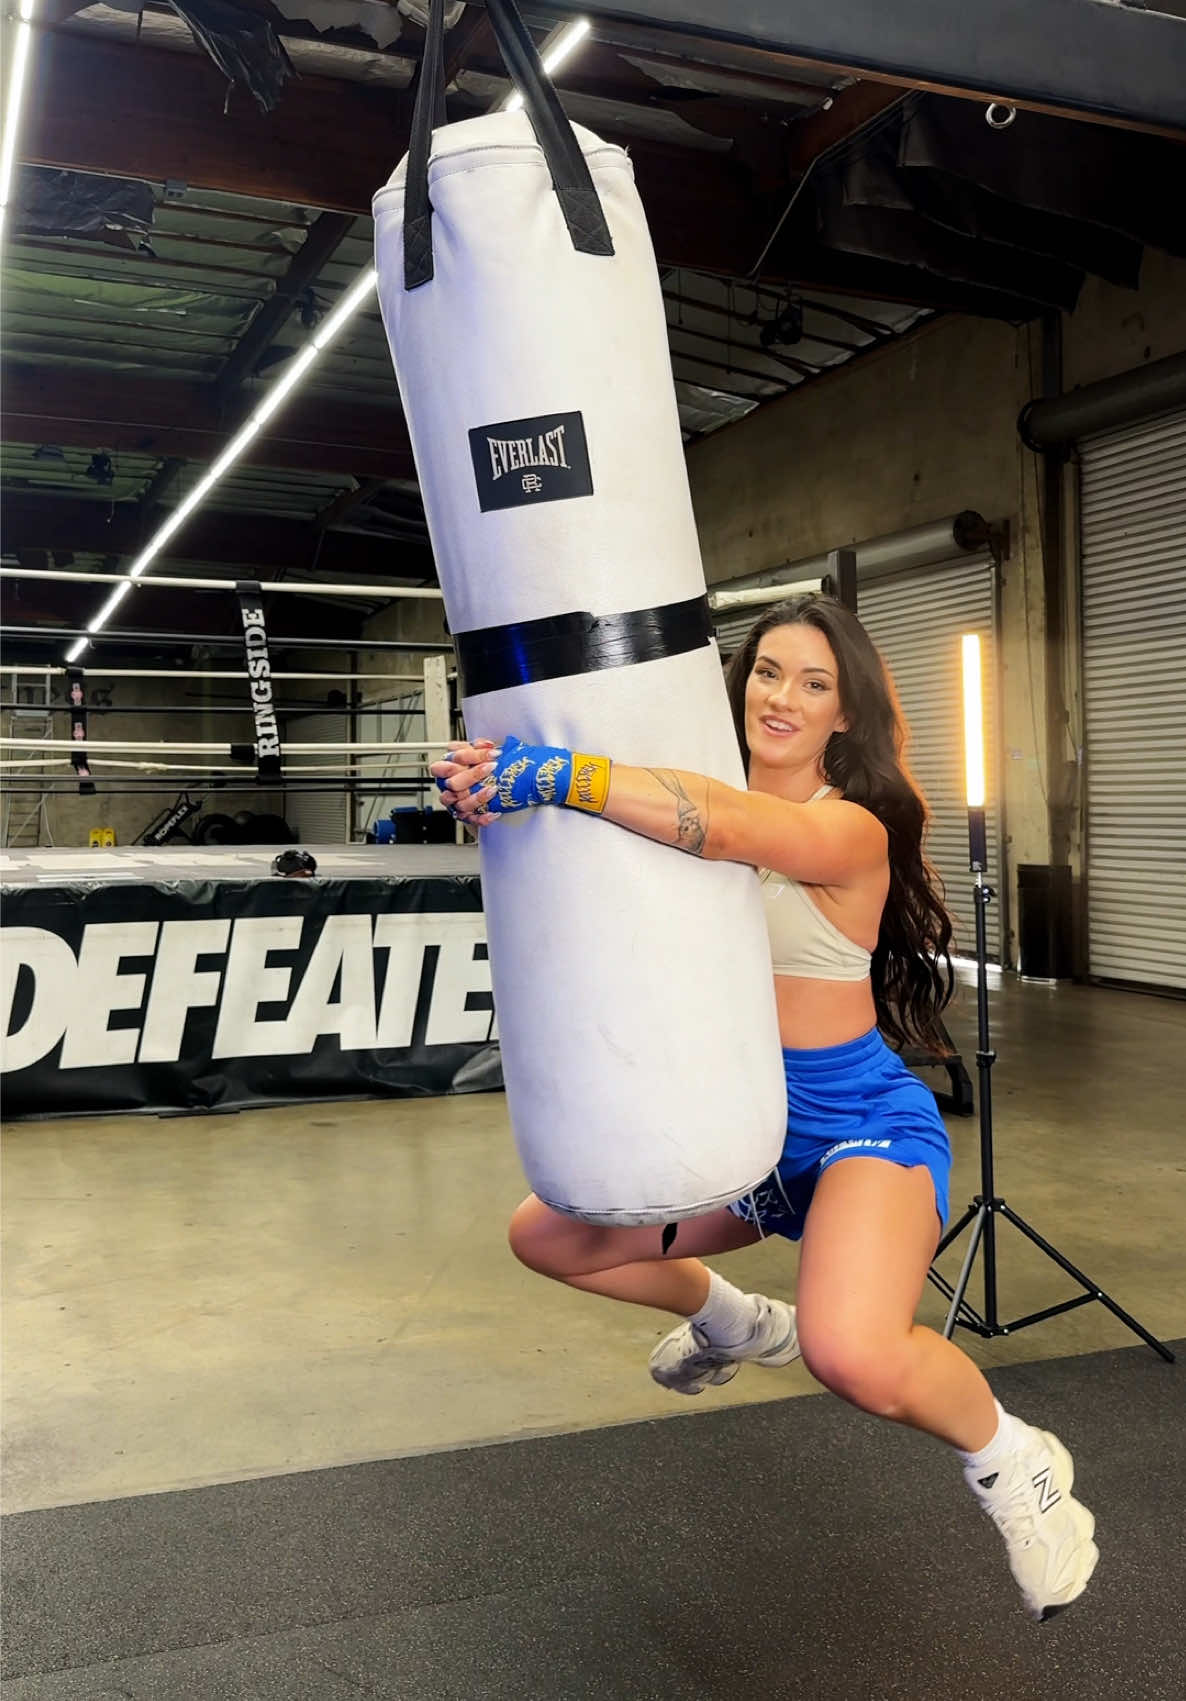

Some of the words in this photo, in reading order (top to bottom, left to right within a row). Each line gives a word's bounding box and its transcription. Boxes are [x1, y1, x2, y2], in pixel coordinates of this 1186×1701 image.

[487, 424, 568, 481] EVERLAST
[241, 608, 281, 758] RINGSIDE
[0, 911, 500, 1074] DEFEATE
